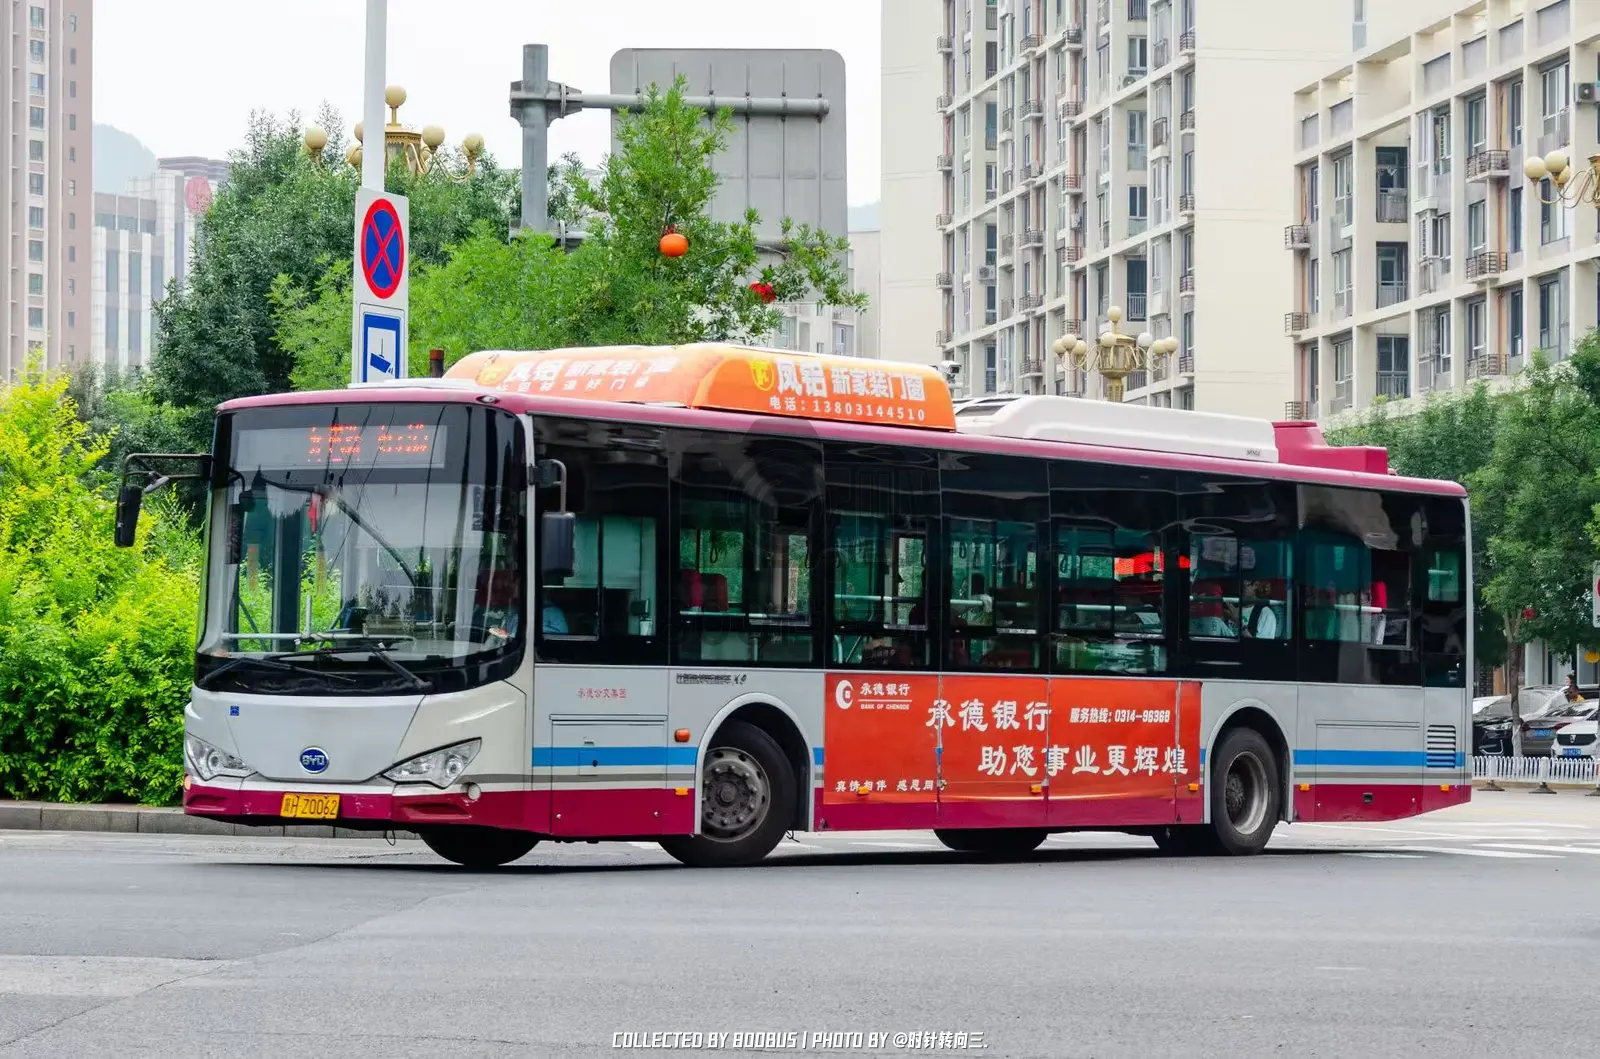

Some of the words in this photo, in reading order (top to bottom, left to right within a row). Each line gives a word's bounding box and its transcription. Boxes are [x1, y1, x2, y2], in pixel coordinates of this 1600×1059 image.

[776, 358, 828, 398] 风铝
[831, 367, 926, 401] 新家装门窗
[769, 395, 925, 421] 电话：13803144510
[860, 682, 911, 696] 承德银行
[925, 698, 1053, 732] 承德银行
[302, 754, 325, 766] BYD
[977, 744, 1188, 777] 助您事业更辉煌
